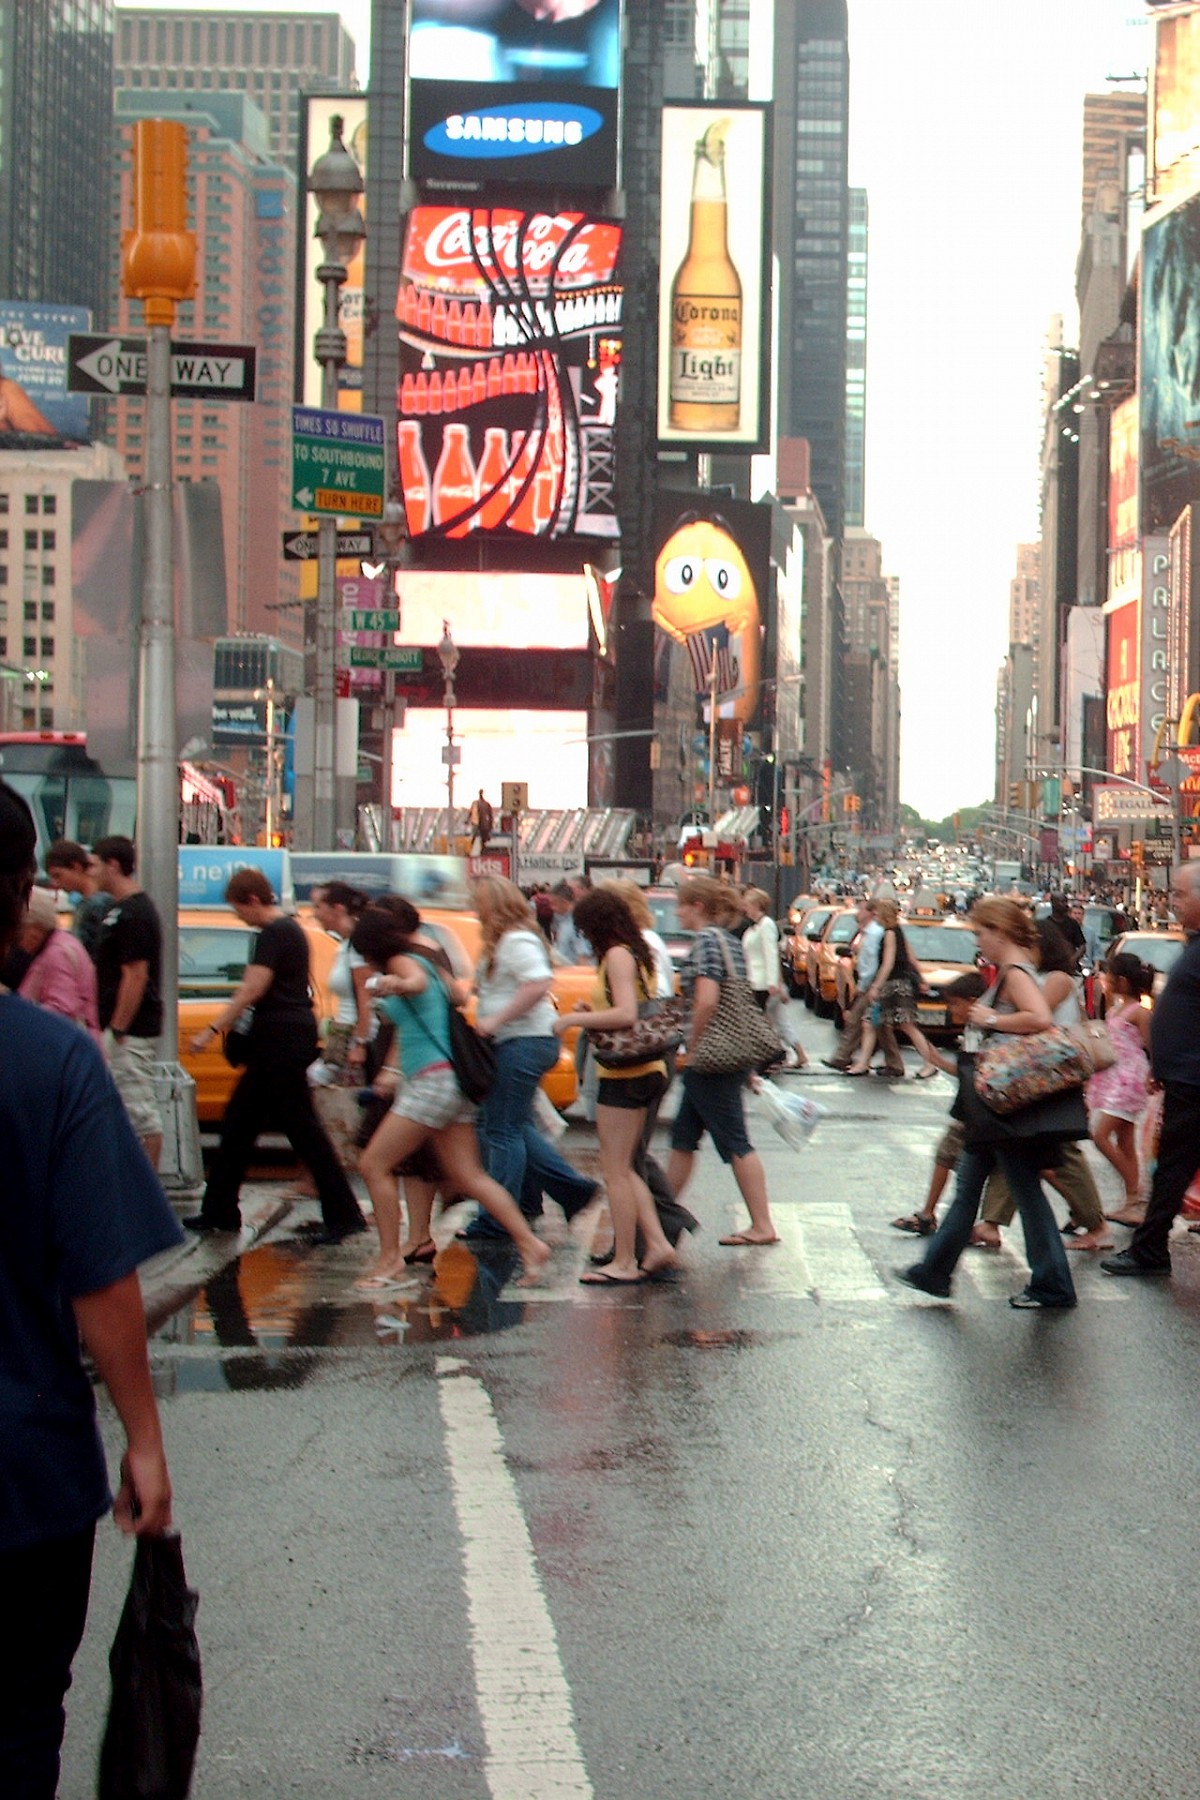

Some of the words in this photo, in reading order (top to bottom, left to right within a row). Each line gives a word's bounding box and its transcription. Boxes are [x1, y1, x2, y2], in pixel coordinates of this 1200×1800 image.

[445, 115, 583, 145] SAMSUNG
[675, 301, 738, 324] Corona
[97, 353, 148, 378] ONE
[176, 360, 232, 383] WAY
[680, 351, 733, 380] Light
[295, 415, 321, 434] TIMES
[342, 420, 382, 442] SHUFFLE
[295, 444, 308, 461] TO
[312, 447, 383, 470] SOUTHBOUND
[322, 468, 330, 484] 7
[335, 472, 356, 488] AVE
[317, 491, 347, 509] TURN
[350, 494, 378, 513] HERE
[355, 612, 365, 629] W
[369, 612, 385, 630] 45
[1152, 554, 1168, 735] PALACE
